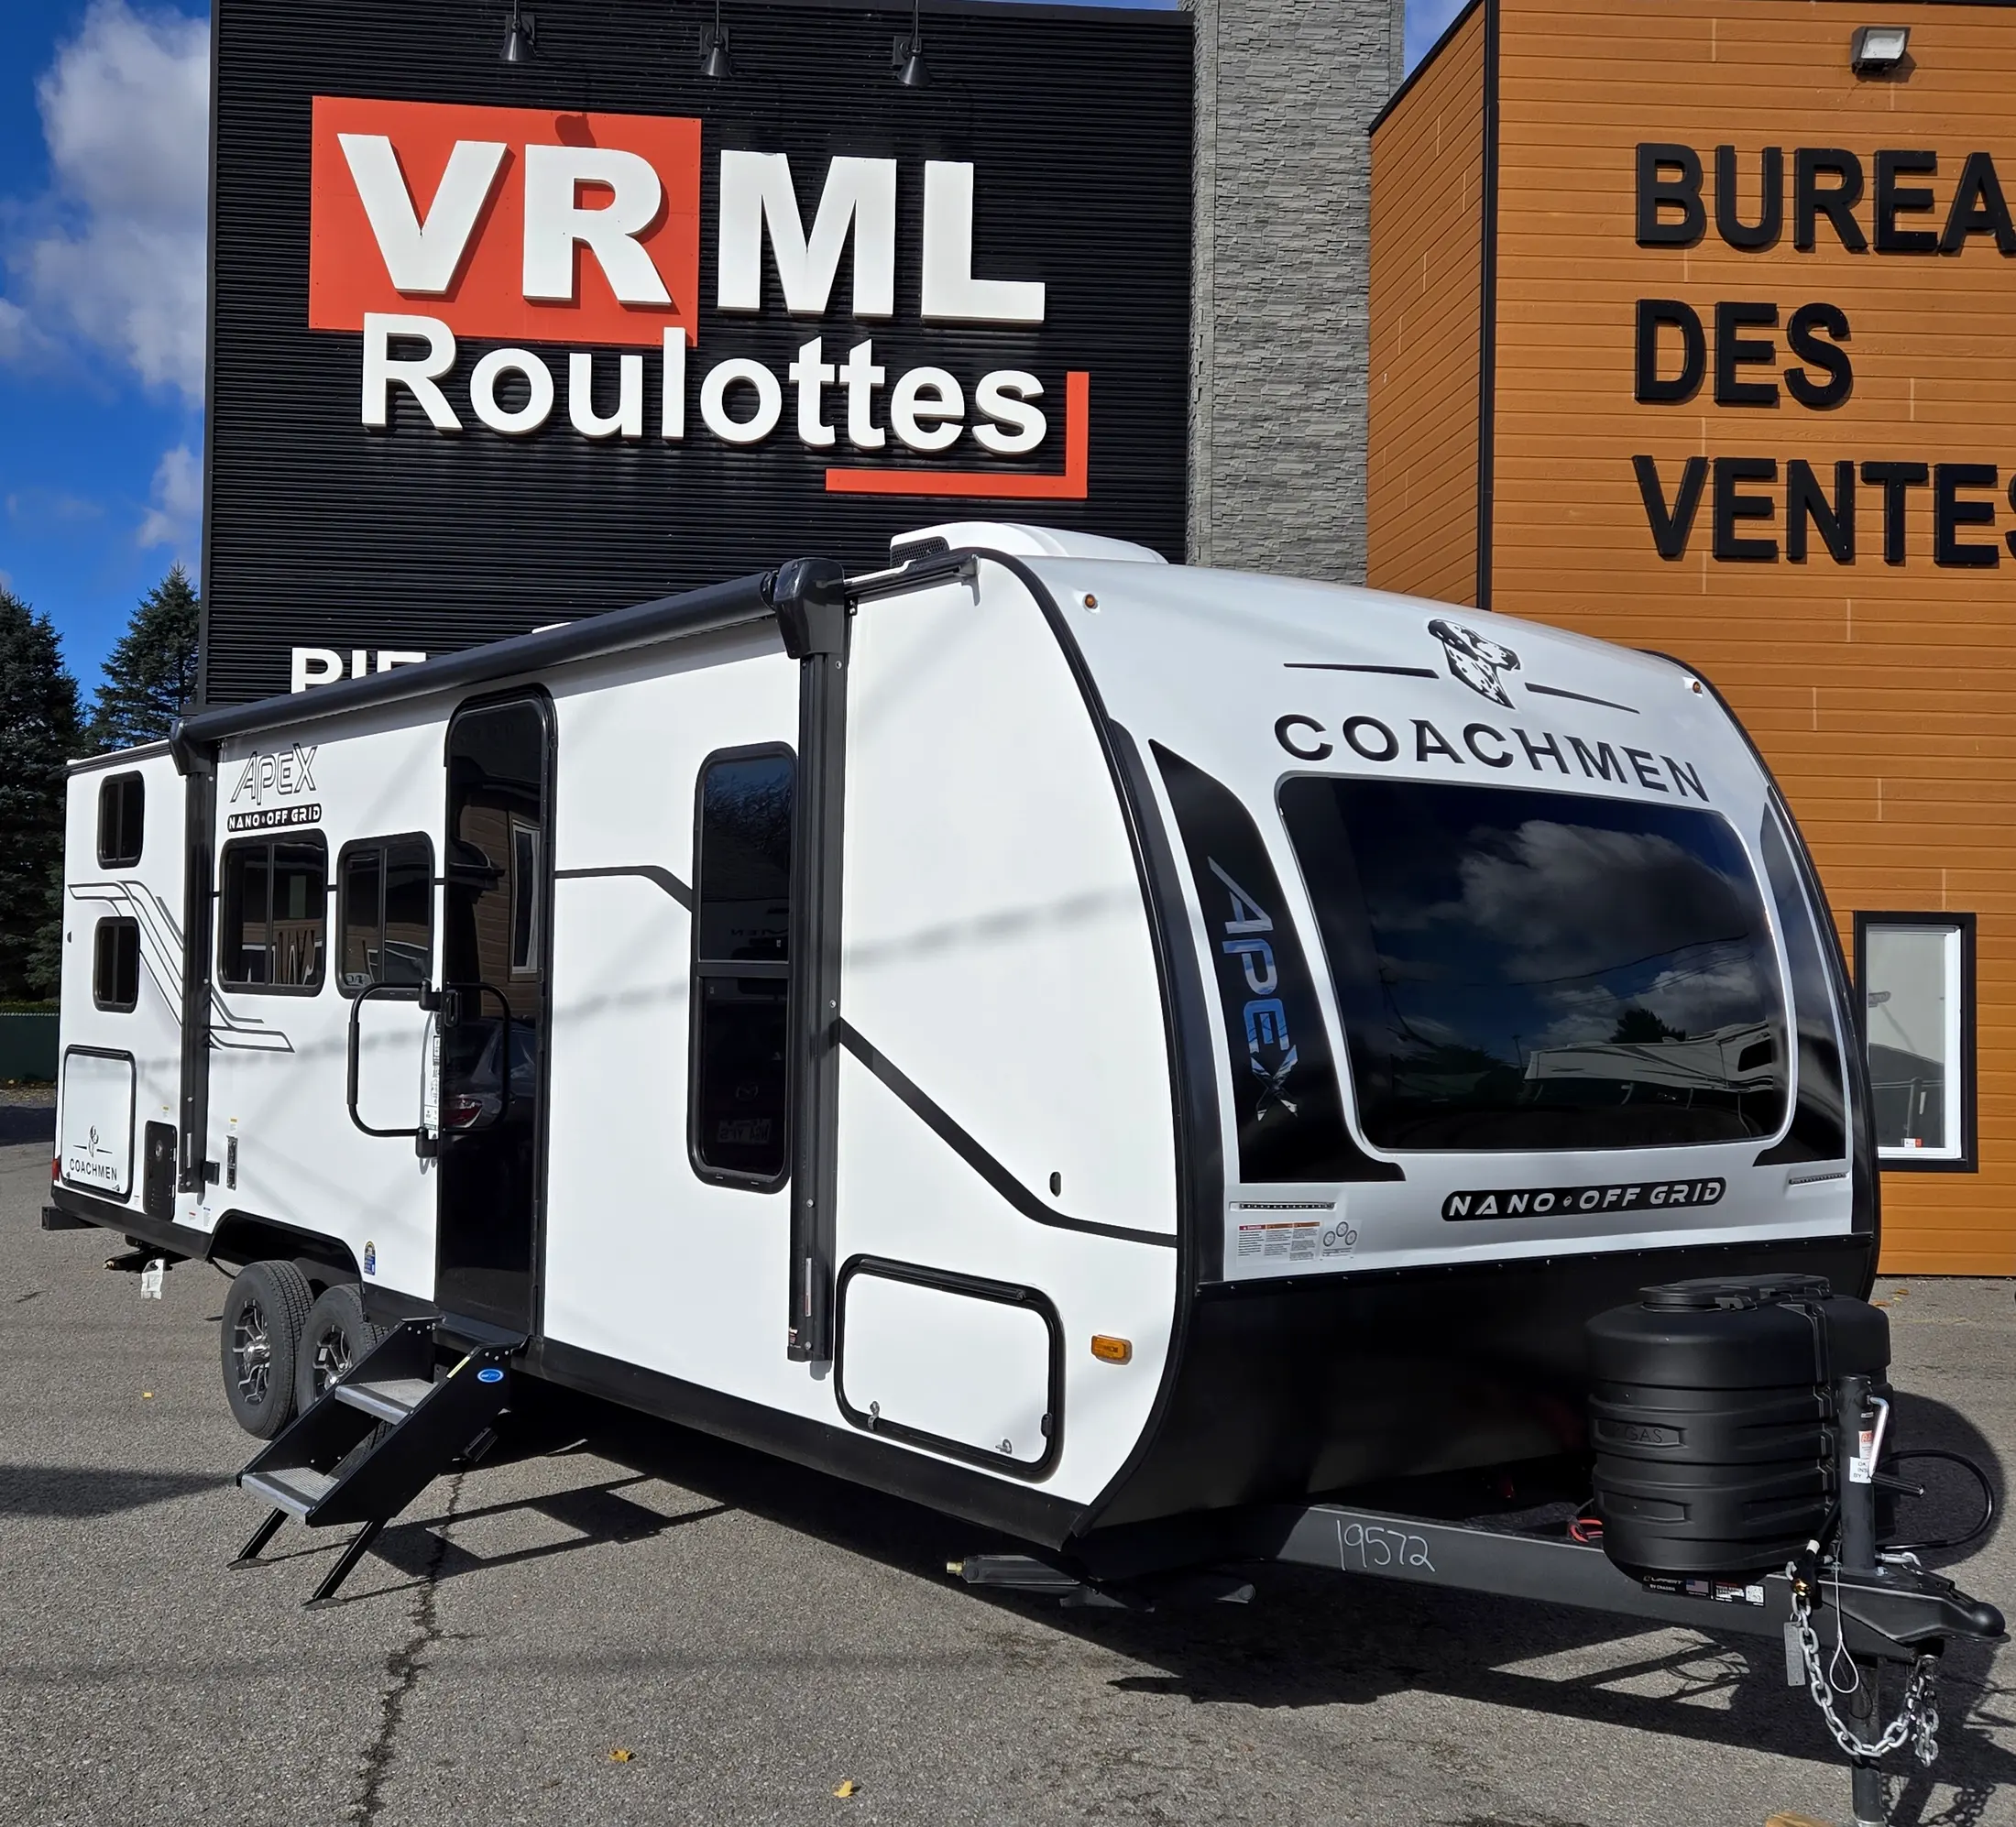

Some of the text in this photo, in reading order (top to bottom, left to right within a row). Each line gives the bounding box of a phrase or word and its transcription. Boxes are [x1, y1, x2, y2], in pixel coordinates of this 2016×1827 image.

[1636, 143, 2016, 254] BUREA
[363, 312, 1047, 456] Roulottes
[1635, 299, 1854, 409] DES
[1633, 455, 2016, 565] VENTE
[229, 742, 318, 806] APEX
[1274, 714, 1711, 803] COACHMEN
[228, 805, 321, 830] NANO OFF GRID
[1207, 856, 1299, 1122] APEX
[69, 1157, 118, 1181] COACHMEN
[1448, 1181, 1722, 1217] NANO OFF GRID
[1625, 1426, 1664, 1445] GAS
[1336, 1519, 1436, 1572] 19572
